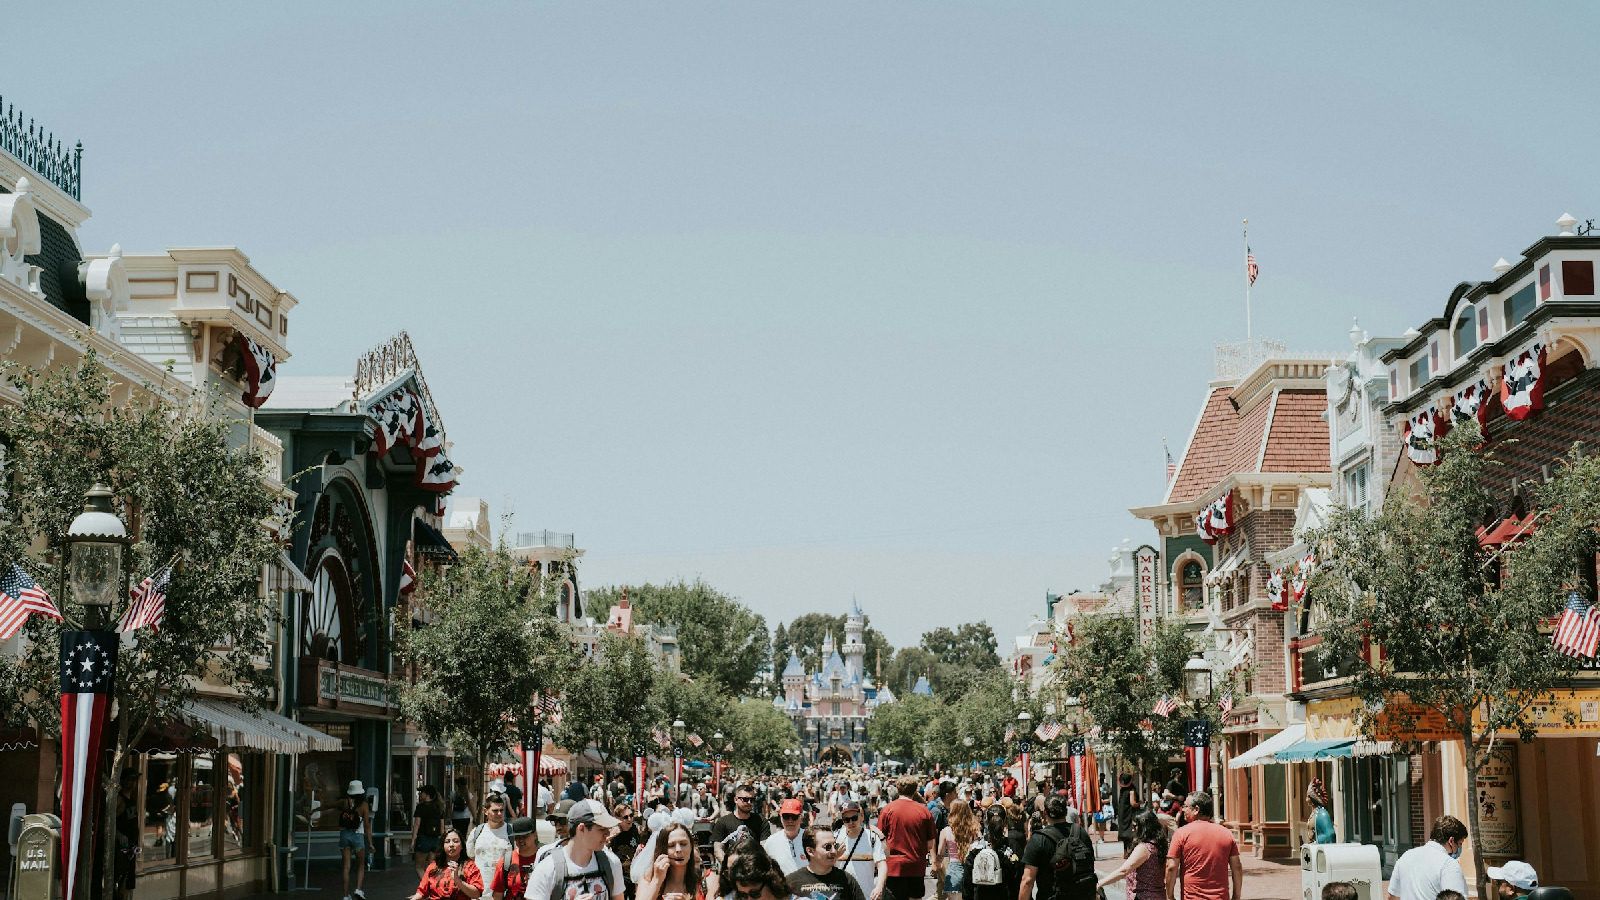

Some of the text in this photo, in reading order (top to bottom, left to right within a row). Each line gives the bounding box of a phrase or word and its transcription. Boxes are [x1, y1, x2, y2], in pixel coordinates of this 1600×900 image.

[1140, 555, 1152, 613] MARKET
[27, 849, 46, 858] U.S.
[20, 860, 50, 870] MAIL
